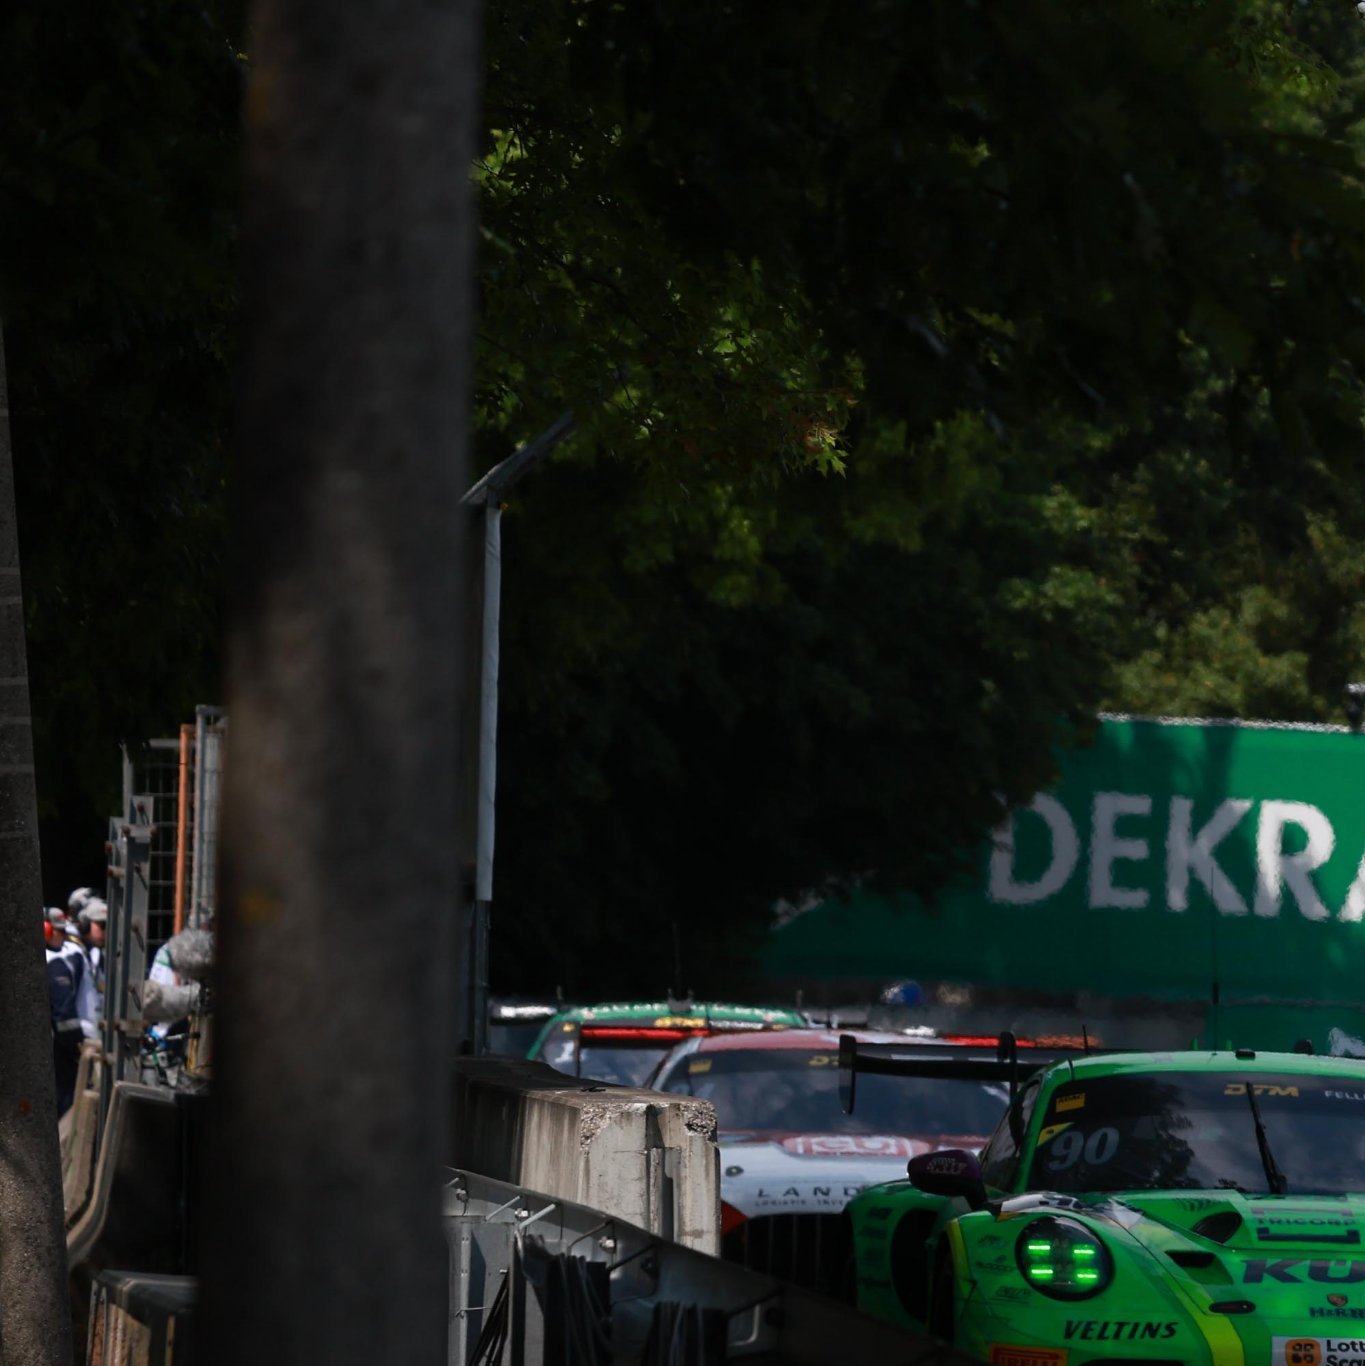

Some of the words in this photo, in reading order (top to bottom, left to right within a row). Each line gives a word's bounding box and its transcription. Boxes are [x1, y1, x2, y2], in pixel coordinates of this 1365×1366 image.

[1224, 1084, 1300, 1097] DTM
[1046, 1127, 1120, 1171] 90
[1064, 1320, 1180, 1340] VELTINS
